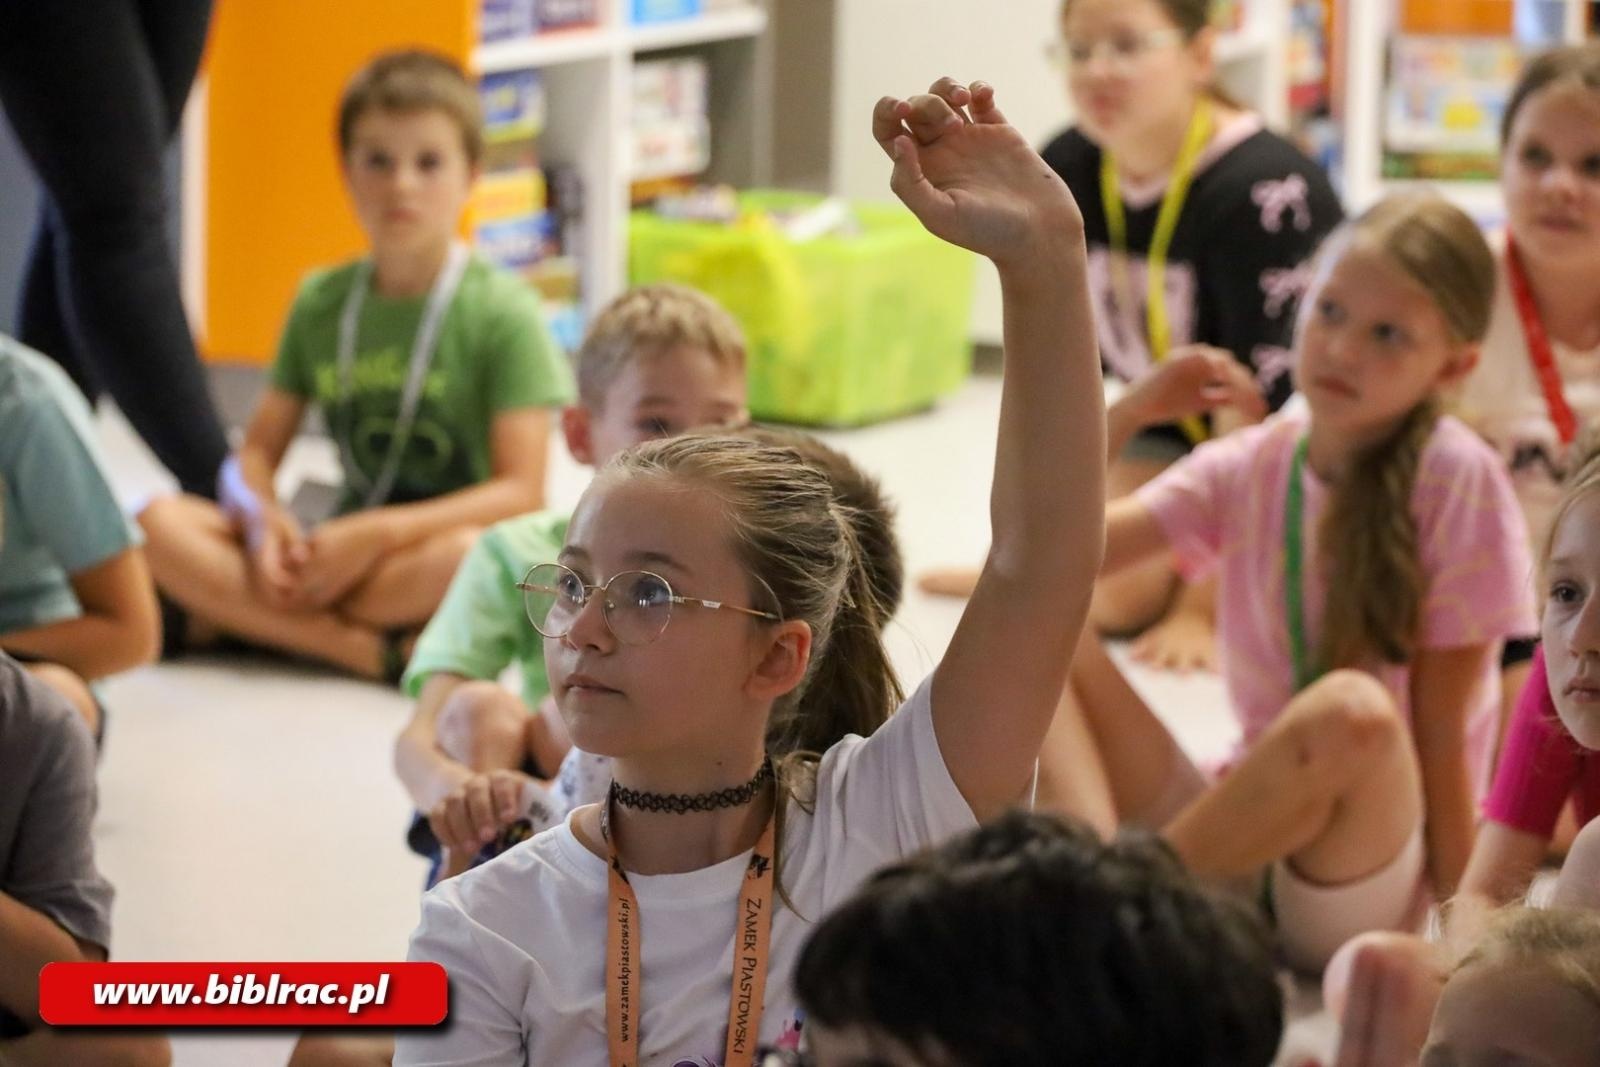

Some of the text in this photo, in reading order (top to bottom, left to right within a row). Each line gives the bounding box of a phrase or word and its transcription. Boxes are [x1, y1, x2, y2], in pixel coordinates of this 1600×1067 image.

[618, 898, 631, 1041] www.zamekpiastowski.pl
[734, 898, 761, 1053] ZAMEK PIASTOWSKI
